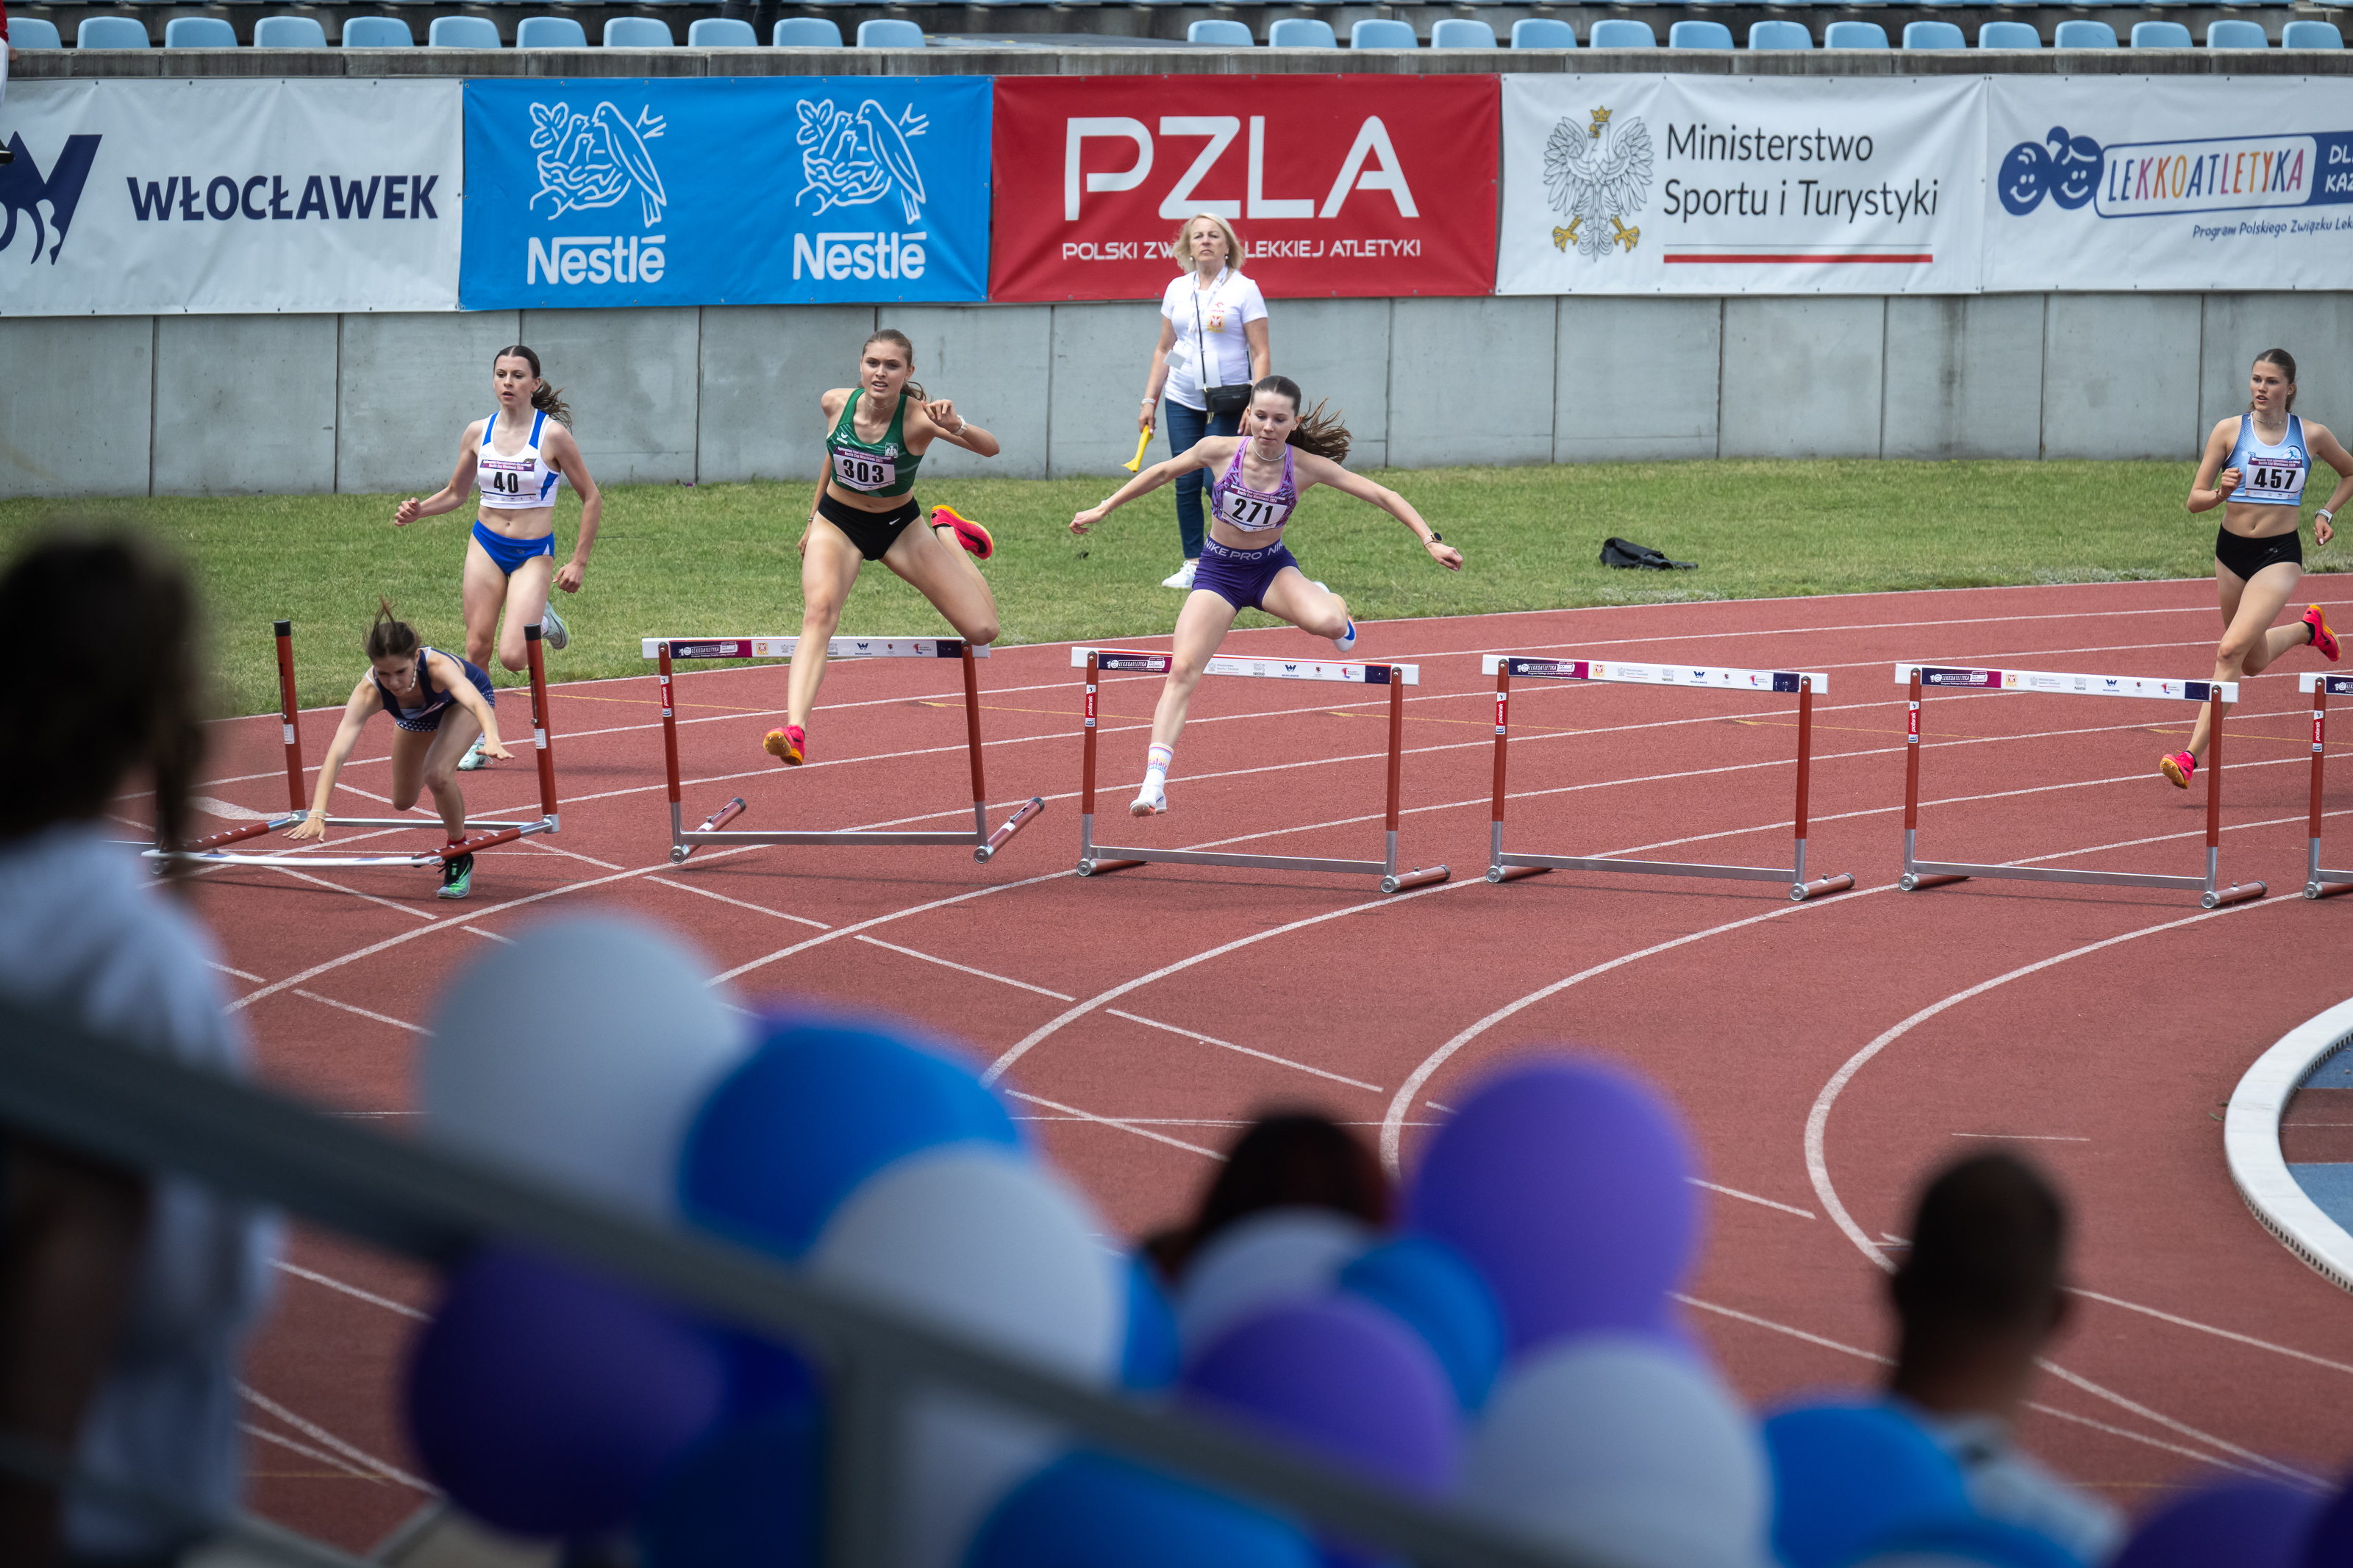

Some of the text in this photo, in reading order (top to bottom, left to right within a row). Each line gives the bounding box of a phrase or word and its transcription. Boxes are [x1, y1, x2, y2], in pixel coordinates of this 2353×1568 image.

[1666, 123, 1874, 162] Ministerstwo
[2328, 144, 2353, 165] DL
[1064, 115, 1420, 221] PZLA
[2107, 148, 2304, 202] LEKKOATLETYKA
[126, 174, 440, 221] WŁOCŁAWEK
[1663, 178, 1939, 223] Sportu i Turystyki
[2192, 224, 2237, 242] Program
[2239, 220, 2288, 239] Polskiego
[2290, 217, 2332, 235] Związku
[1063, 242, 1138, 260] POLSKI
[1244, 239, 1421, 258] LEKKIEJ ATLETYKI
[493, 471, 519, 494] 40
[843, 459, 885, 484] 303
[2254, 468, 2297, 490] 457
[1232, 498, 1274, 525] 271
[1205, 537, 1283, 560] NIKE PRO NIK
